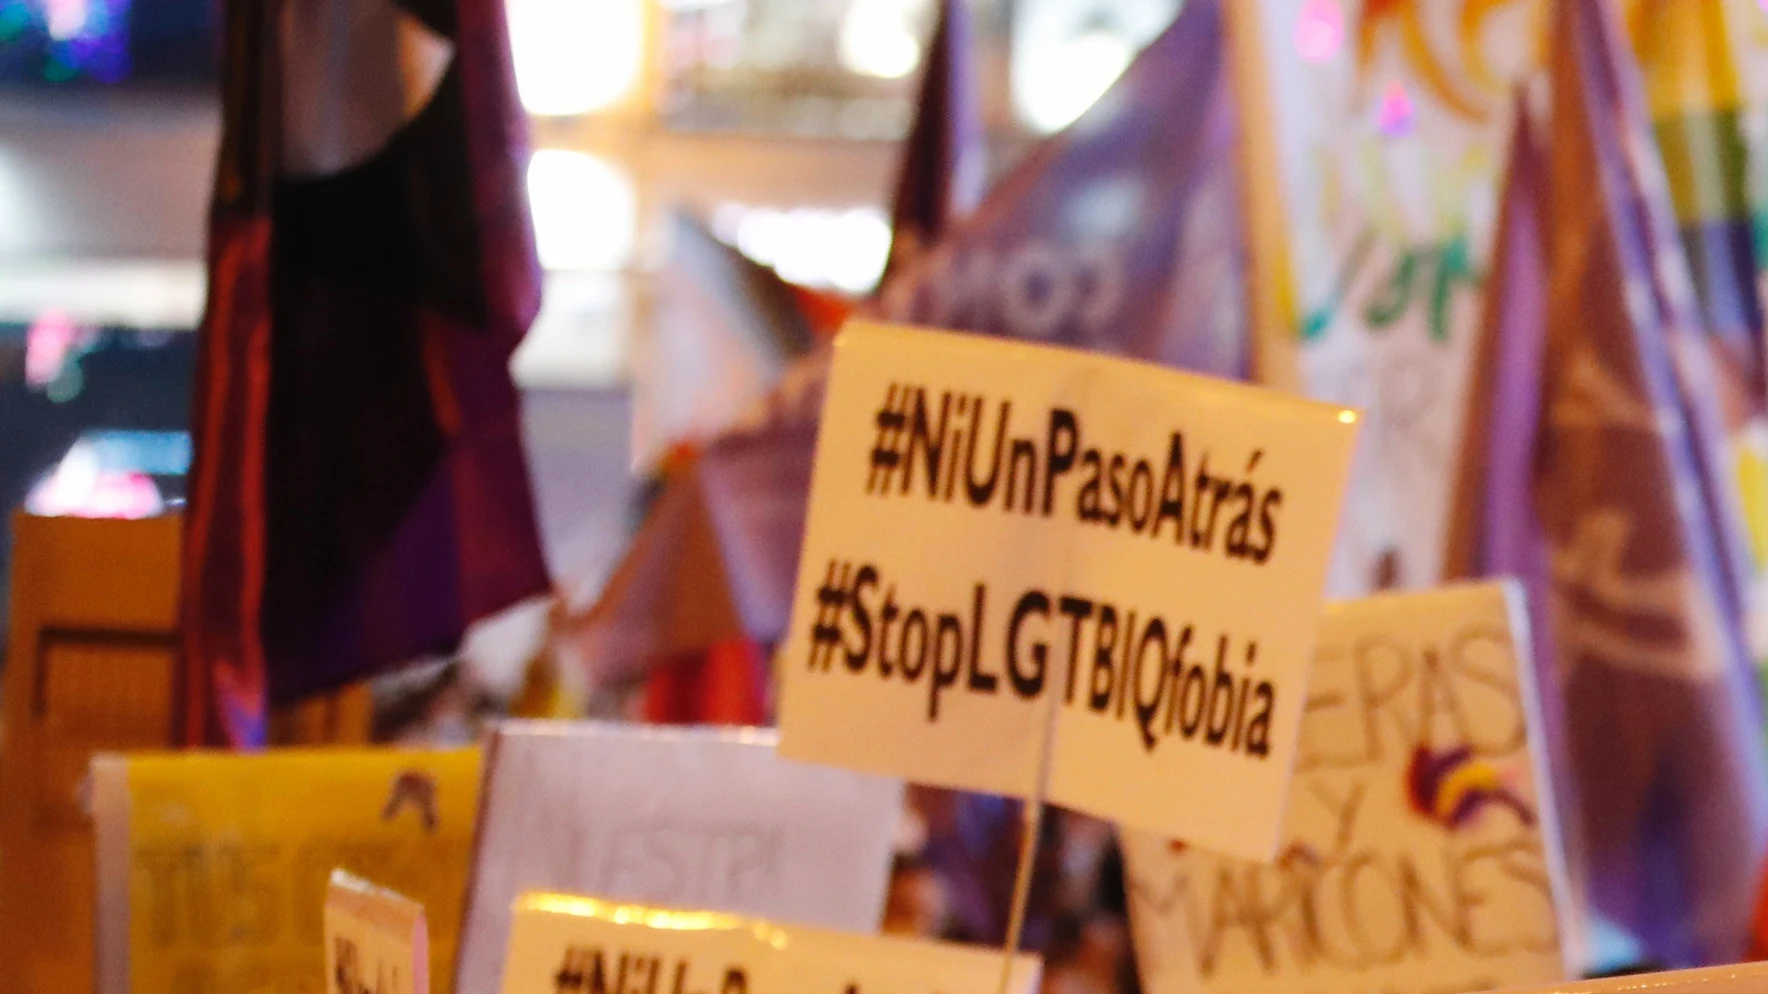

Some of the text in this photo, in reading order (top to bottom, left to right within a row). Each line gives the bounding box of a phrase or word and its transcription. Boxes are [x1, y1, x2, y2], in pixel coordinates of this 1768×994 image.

[866, 382, 1283, 566] #NiUnPasoAtrás
[807, 559, 1275, 760] #StopLGTBIQfobia
[1293, 622, 1530, 773] ERAS
